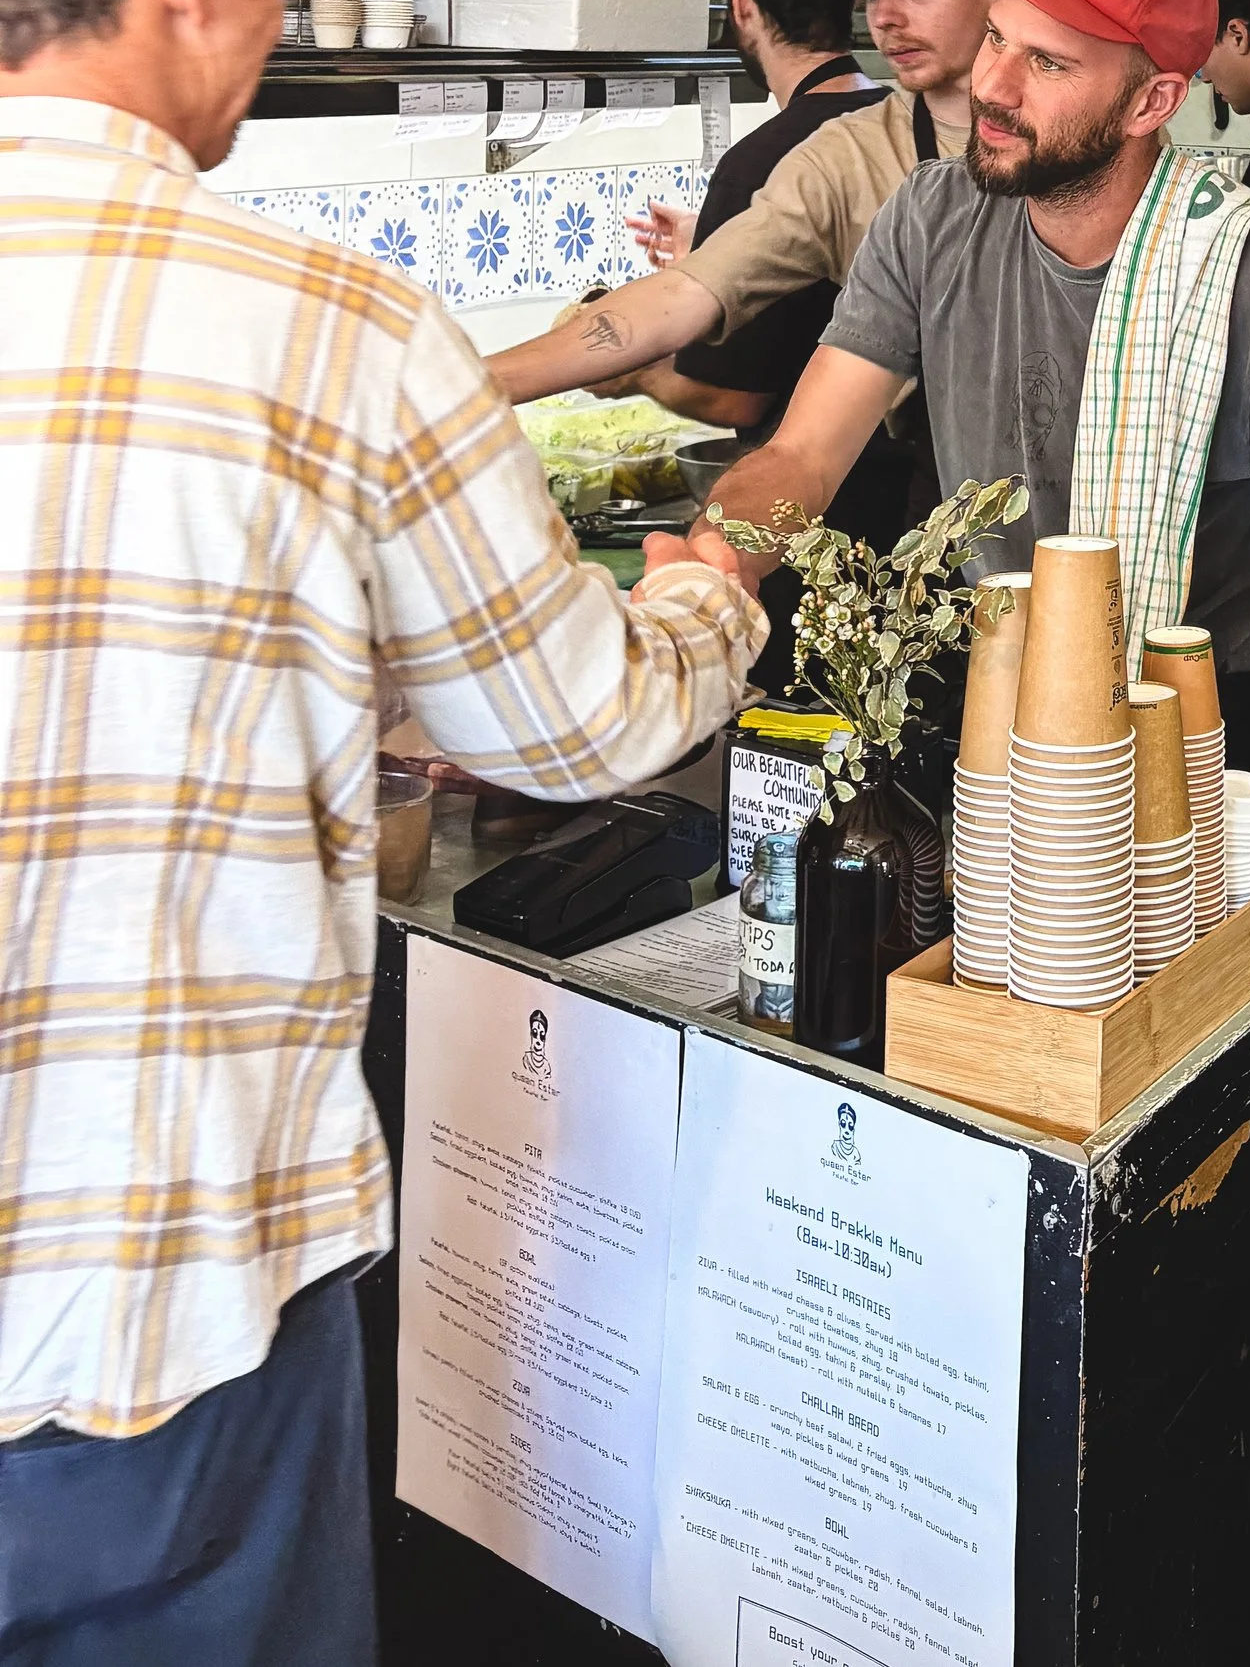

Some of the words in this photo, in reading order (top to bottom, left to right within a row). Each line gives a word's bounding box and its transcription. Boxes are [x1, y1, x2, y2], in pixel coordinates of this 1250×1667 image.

[732, 751, 757, 772] OUR
[759, 755, 818, 791] BEAUTIFU
[763, 779, 823, 809] COMMUNITY
[732, 795, 764, 812] PLEASE
[767, 804, 790, 820] NOTE
[732, 811, 757, 827] WILL
[761, 818, 777, 831] BE
[753, 958, 785, 974] TODA
[524, 1143, 543, 1159] PITA
[819, 1157, 845, 1173] queen
[847, 1164, 872, 1182] Ester
[766, 1186, 825, 1223] Weekend
[889, 1235, 923, 1266] Menu
[796, 1224, 892, 1279] (8am-10:30am)
[795, 1268, 838, 1297] ISRAELI
[842, 1287, 891, 1321] PASTRIES
[697, 1255, 718, 1271] ZIVA
[727, 1267, 750, 1284] filled
[752, 1279, 769, 1291] with
[771, 1286, 793, 1301] mixed
[795, 1295, 825, 1314] cheese
[865, 1322, 894, 1345] Served
[896, 1341, 913, 1355] with
[942, 1363, 961, 1380] egg,
[963, 1371, 990, 1394] tahini,
[786, 1306, 820, 1326] crushed
[822, 1319, 862, 1346] tomatoes,
[888, 1349, 899, 1363] 18
[739, 1301, 780, 1326] (savoury)
[788, 1323, 806, 1336] roll
[808, 1331, 825, 1344] with
[827, 1336, 859, 1360] hummus,
[885, 1366, 919, 1388] crushed
[922, 1381, 952, 1407] tomato,
[954, 1401, 988, 1424] pickles,
[804, 1344, 822, 1360] egg,
[896, 1383, 906, 1397] 19
[777, 1347, 808, 1369] (sweet)
[817, 1368, 834, 1381] roll
[837, 1376, 854, 1390] with
[855, 1385, 887, 1405] nutella
[936, 1422, 947, 1436] 17
[801, 1390, 844, 1422] CHALLAH
[847, 1412, 880, 1438] BREAD
[702, 1375, 732, 1396] SALAMI
[743, 1391, 760, 1406] EGG
[769, 1404, 803, 1427] crunchy
[805, 1417, 825, 1434] beef
[857, 1441, 863, 1453] 2
[866, 1445, 887, 1465] fried
[889, 1460, 912, 1479] eggs,
[697, 1412, 728, 1433] CHEESE
[730, 1424, 770, 1449] OMELETTE
[780, 1447, 797, 1461] with
[841, 1473, 872, 1498] labneh,
[900, 1502, 923, 1524] fresh
[925, 1519, 969, 1549] cucumbers
[770, 1421, 793, 1438] mayo,
[795, 1432, 825, 1451] pickles
[836, 1451, 858, 1467] mixed
[898, 1478, 908, 1492] 19
[804, 1474, 826, 1491] mixed
[861, 1499, 873, 1513] 19
[824, 1516, 850, 1540] BOWL
[685, 1521, 718, 1542] CHEESE
[719, 1533, 761, 1559] OMELETTE
[771, 1556, 789, 1570] with
[791, 1565, 814, 1581] mixed
[816, 1576, 847, 1599] greens,
[849, 1593, 890, 1623] cucumber,
[924, 1633, 951, 1657] fennel
[741, 1508, 759, 1521] with
[761, 1515, 785, 1531] mixed
[787, 1526, 819, 1547] greens,
[821, 1542, 862, 1570] cucumber,
[896, 1578, 922, 1602] fennel
[924, 1598, 951, 1619] salad,
[953, 1610, 985, 1638] labneh,
[793, 1544, 823, 1562] zaatar
[834, 1563, 864, 1585] pickles
[867, 1578, 879, 1593] 20
[751, 1561, 784, 1584] labneh,
[786, 1578, 819, 1599] zaatar,
[870, 1620, 902, 1643] pickles
[904, 1636, 916, 1651] 20
[768, 1625, 805, 1652] Boost
[810, 1645, 838, 1666] your
